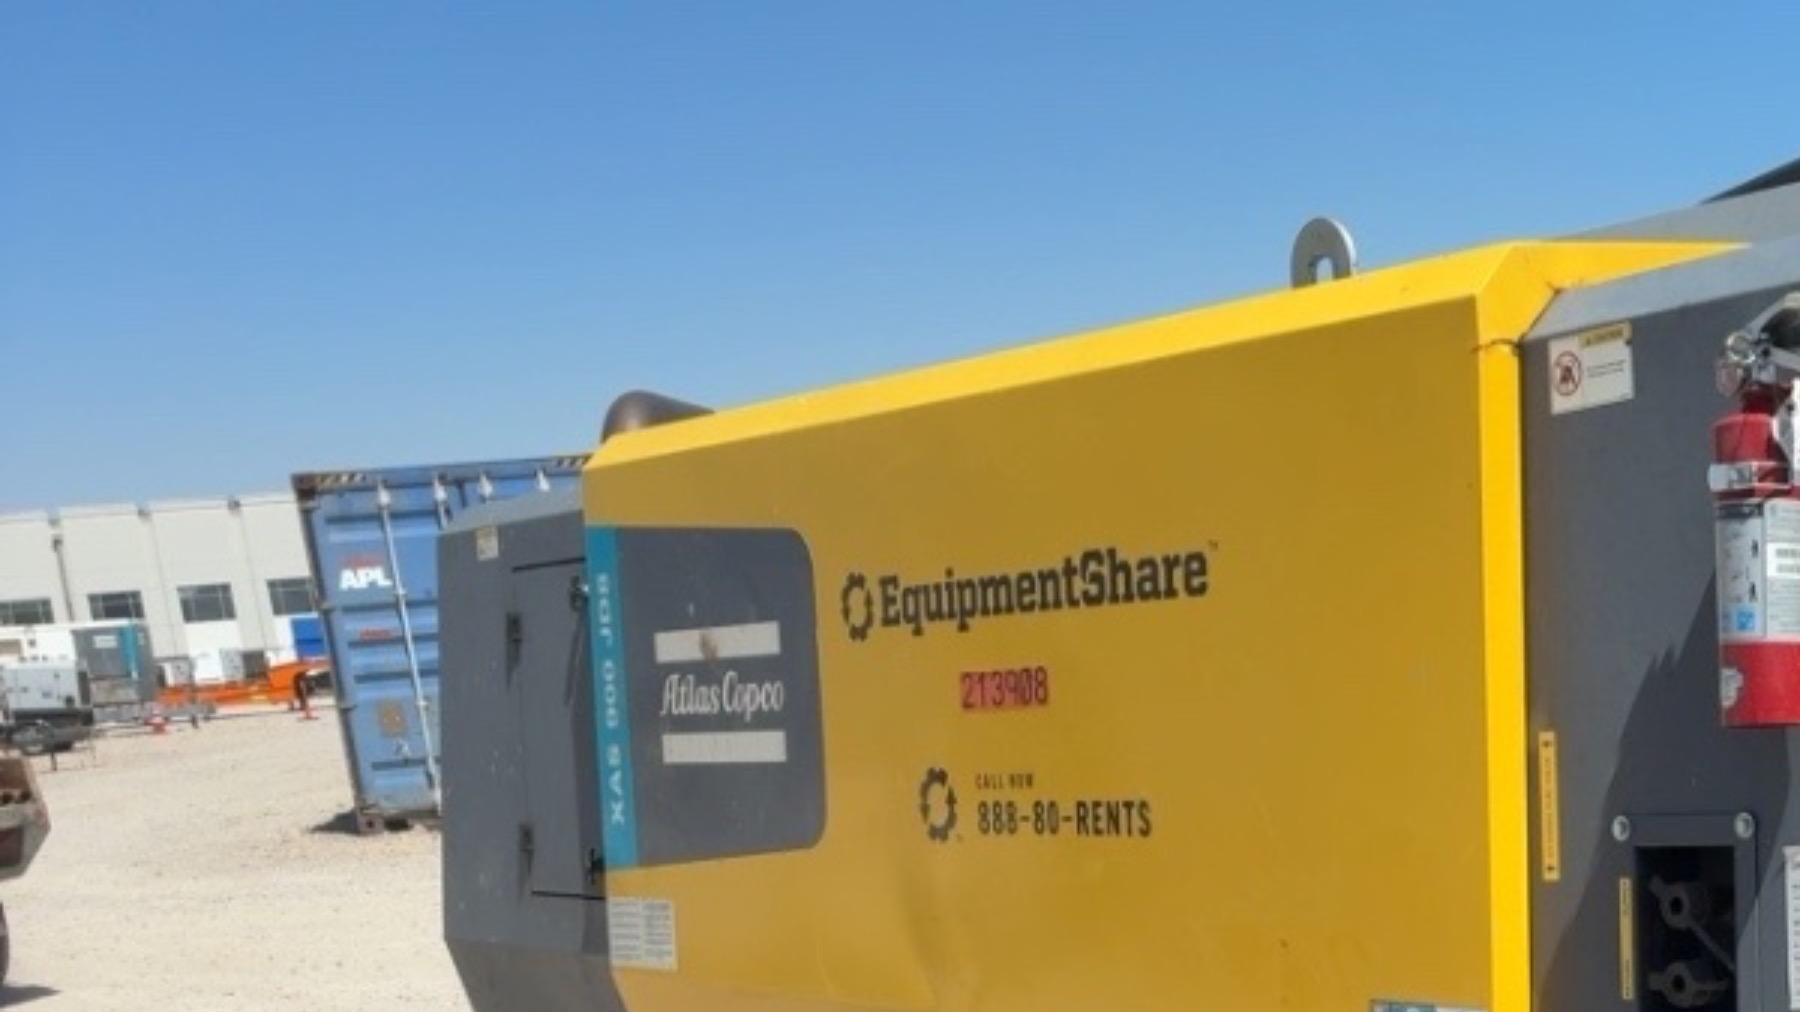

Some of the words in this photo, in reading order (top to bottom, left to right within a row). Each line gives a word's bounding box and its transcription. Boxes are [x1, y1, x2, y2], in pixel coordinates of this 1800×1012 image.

[339, 567, 393, 591] APL
[878, 547, 1208, 636] EquipmentShare
[659, 673, 722, 718] Atlas
[722, 669, 786, 723] Copco
[960, 665, 1049, 710] 213908
[974, 773, 1004, 790] CALL
[976, 799, 1152, 838] 888-80-RENTS
